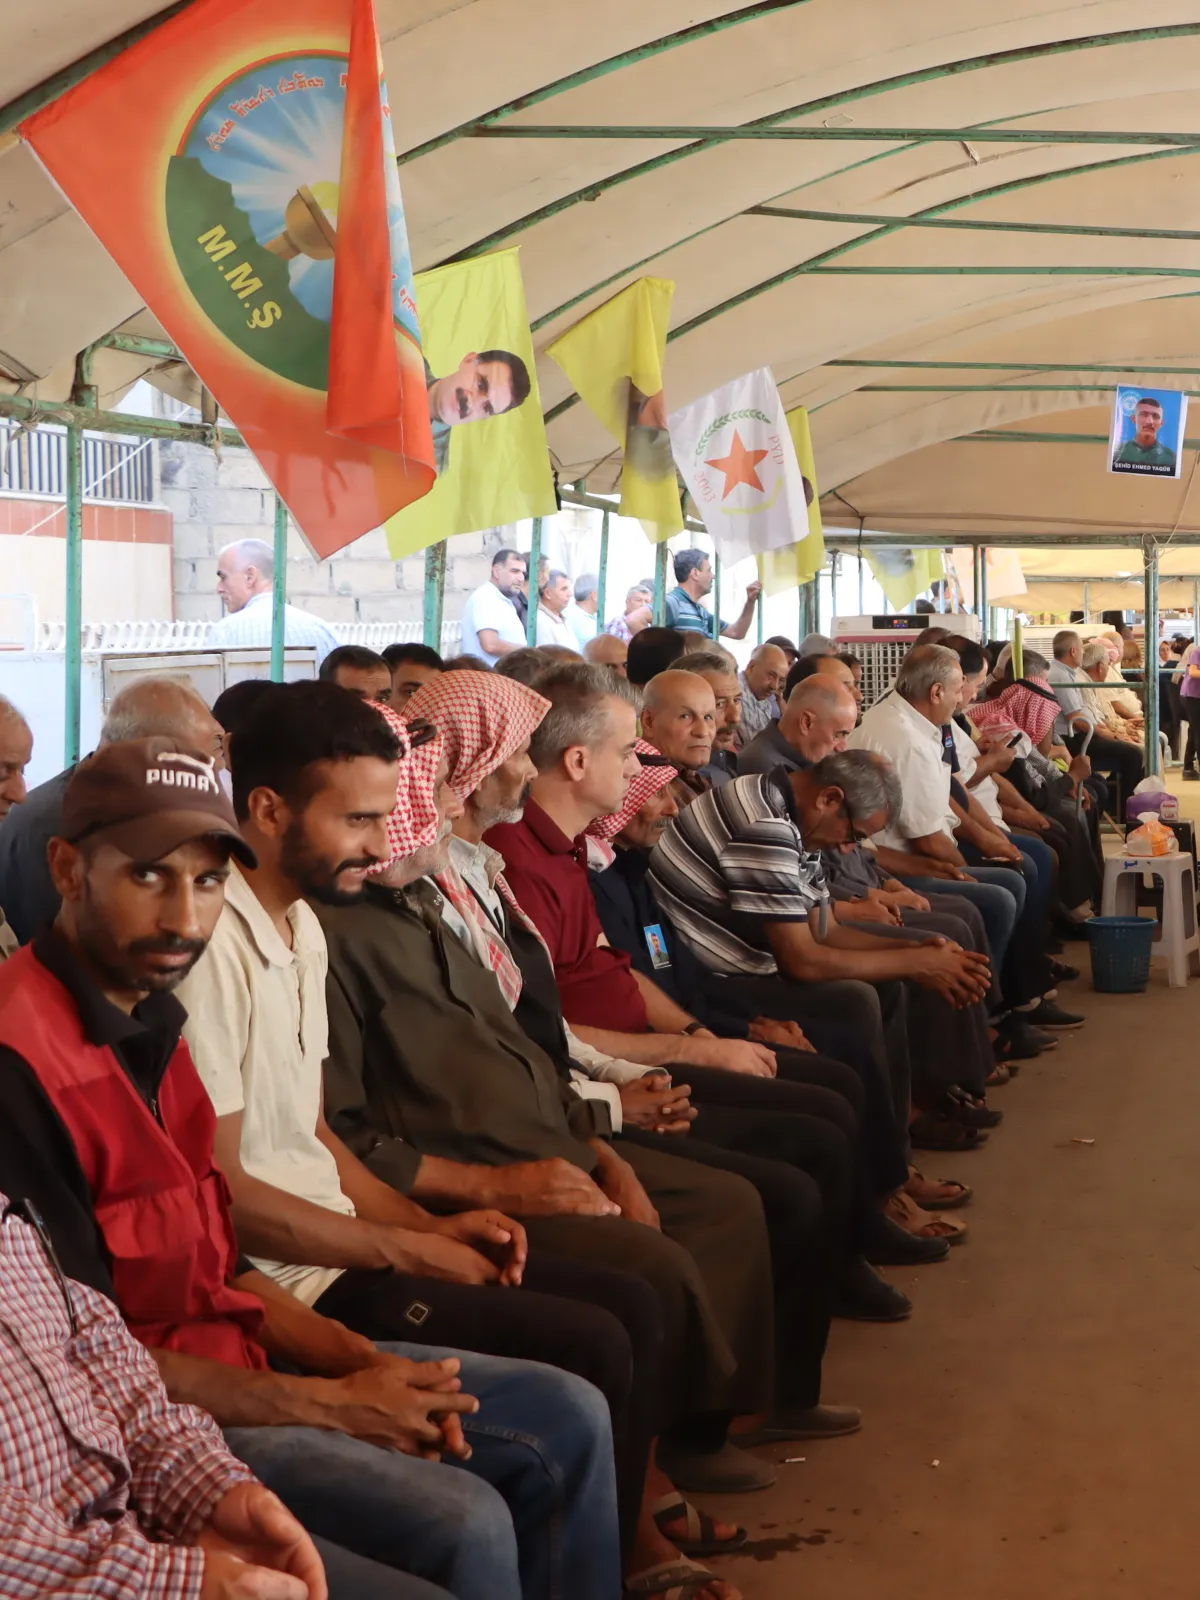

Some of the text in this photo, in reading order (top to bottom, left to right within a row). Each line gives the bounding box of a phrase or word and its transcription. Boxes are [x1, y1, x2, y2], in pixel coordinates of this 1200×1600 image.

[197, 224, 282, 329] M.M.Ş
[693, 471, 717, 503] 2003
[146, 769, 210, 792] PUMA
